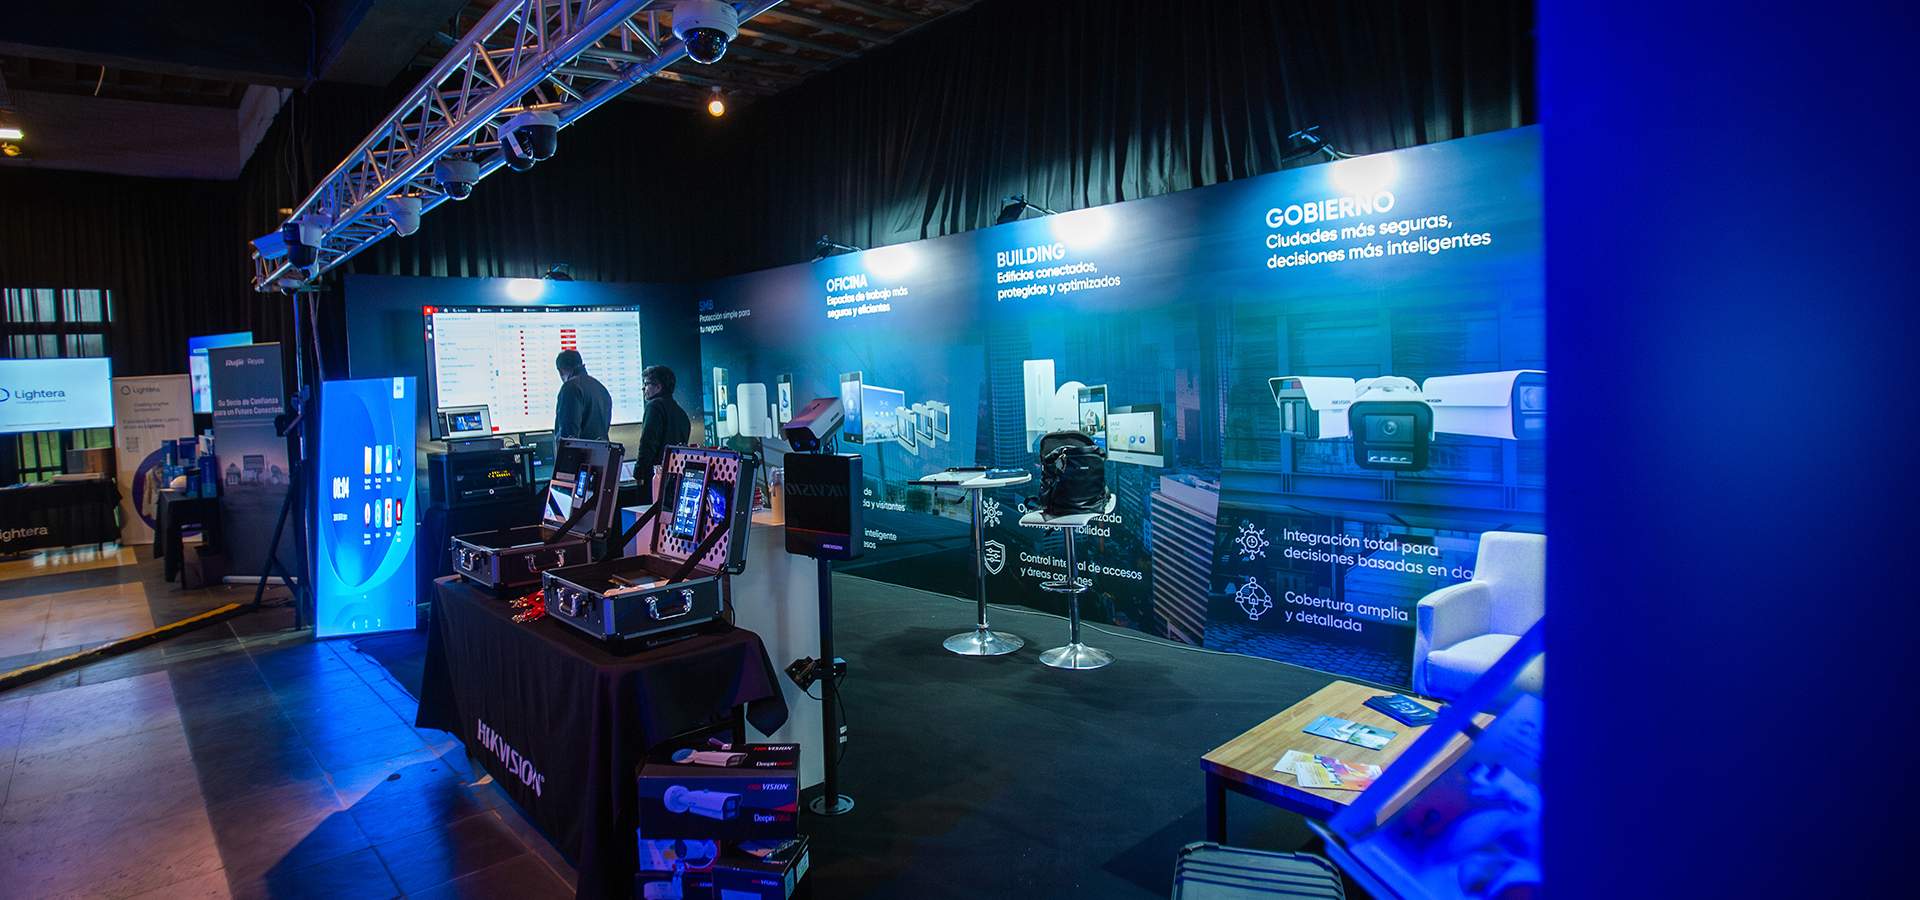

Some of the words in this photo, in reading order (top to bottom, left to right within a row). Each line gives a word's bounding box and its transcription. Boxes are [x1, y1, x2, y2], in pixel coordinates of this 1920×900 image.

[1266, 190, 1395, 228] GOBIERNO
[1266, 226, 1338, 249] Ciudades
[1341, 222, 1376, 240] más
[1379, 214, 1453, 236] seguras,
[997, 242, 1066, 268] BUILDING
[1267, 247, 1346, 269] decisiones
[1349, 242, 1384, 260] más
[1387, 231, 1492, 255] inteligentes
[826, 273, 868, 292] OFICINA
[997, 269, 1035, 283] Edificios
[1035, 261, 1098, 279] conectados,
[827, 293, 855, 307] Espacios
[855, 291, 865, 302] de
[865, 288, 891, 301] trabajo
[892, 285, 909, 297] más
[997, 283, 1048, 301] protegidos
[1049, 283, 1056, 296] y
[1057, 275, 1121, 295] optimizados
[699, 299, 714, 312] SMB
[723, 310, 738, 320] simple
[738, 309, 751, 319] para
[827, 307, 852, 319] seguros
[852, 307, 857, 318] y
[858, 303, 891, 315] eficientes
[15, 390, 66, 401] Lightera
[132, 386, 160, 394] Lightera
[213, 409, 227, 417] para
[234, 407, 253, 416] Futuro
[253, 405, 284, 415] Conectado
[226, 398, 241, 406] Socio
[242, 398, 250, 406] de
[250, 397, 279, 405] Confianza
[875, 500, 906, 512] visitantes
[864, 527, 898, 541] inteligente
[1283, 528, 1361, 548] Integración
[1363, 536, 1398, 552] total
[1401, 542, 1439, 557] para
[1019, 551, 1051, 566] Control
[1052, 556, 1086, 571] inteal
[1088, 562, 1101, 574] de
[1102, 566, 1143, 581] accesos
[1020, 568, 1026, 577] y
[1026, 566, 1052, 579] áreas
[1284, 546, 1355, 566] decisiones
[1358, 554, 1423, 575] basadas
[1427, 565, 1448, 577] en
[1451, 565, 1474, 580] da
[1284, 590, 1354, 613] Cobertura
[1357, 602, 1409, 621] amplia
[1285, 610, 1293, 623] y
[1295, 611, 1363, 632] detallada
[477, 718, 542, 797] HIKVISION
[748, 783, 789, 791] HIKVISION
